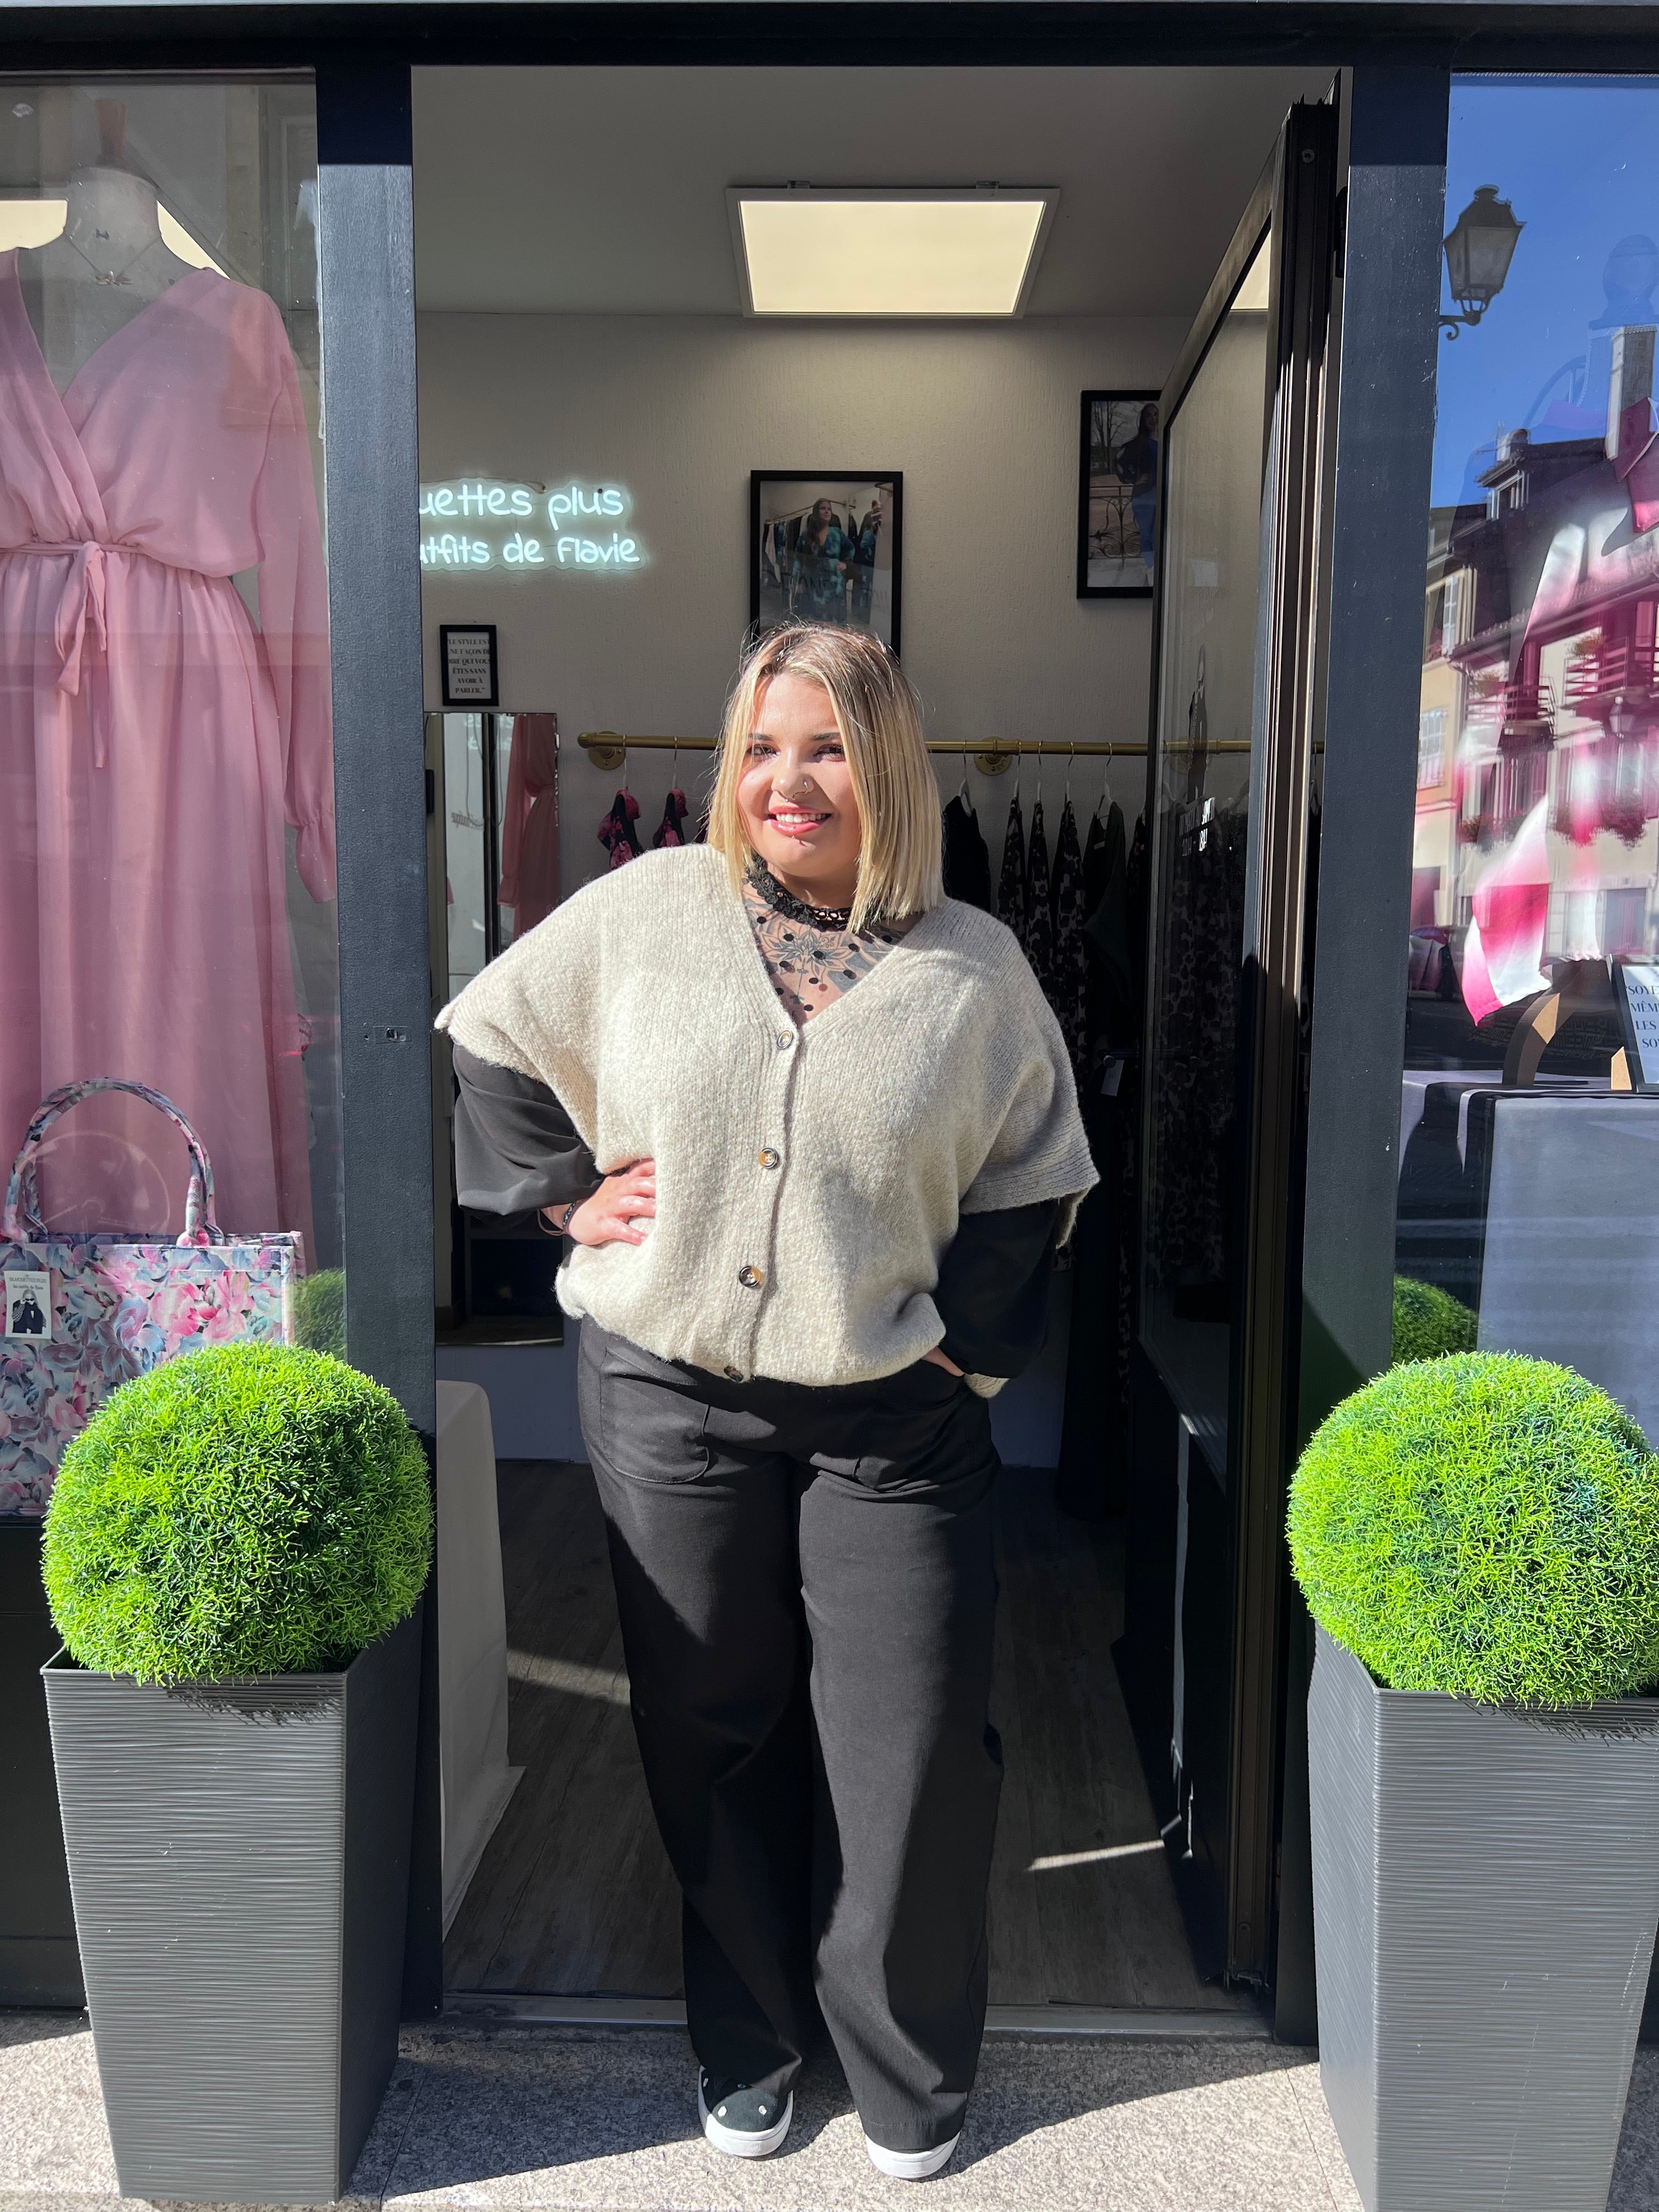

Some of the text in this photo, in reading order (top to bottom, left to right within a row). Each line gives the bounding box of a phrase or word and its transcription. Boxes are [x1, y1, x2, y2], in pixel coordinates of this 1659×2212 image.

[548, 487, 624, 531] plus
[503, 532, 545, 563] de
[1630, 1001, 1659, 1012] MÊM
[1635, 1020, 1656, 1030] LES
[1642, 1038, 1659, 1048] SO
